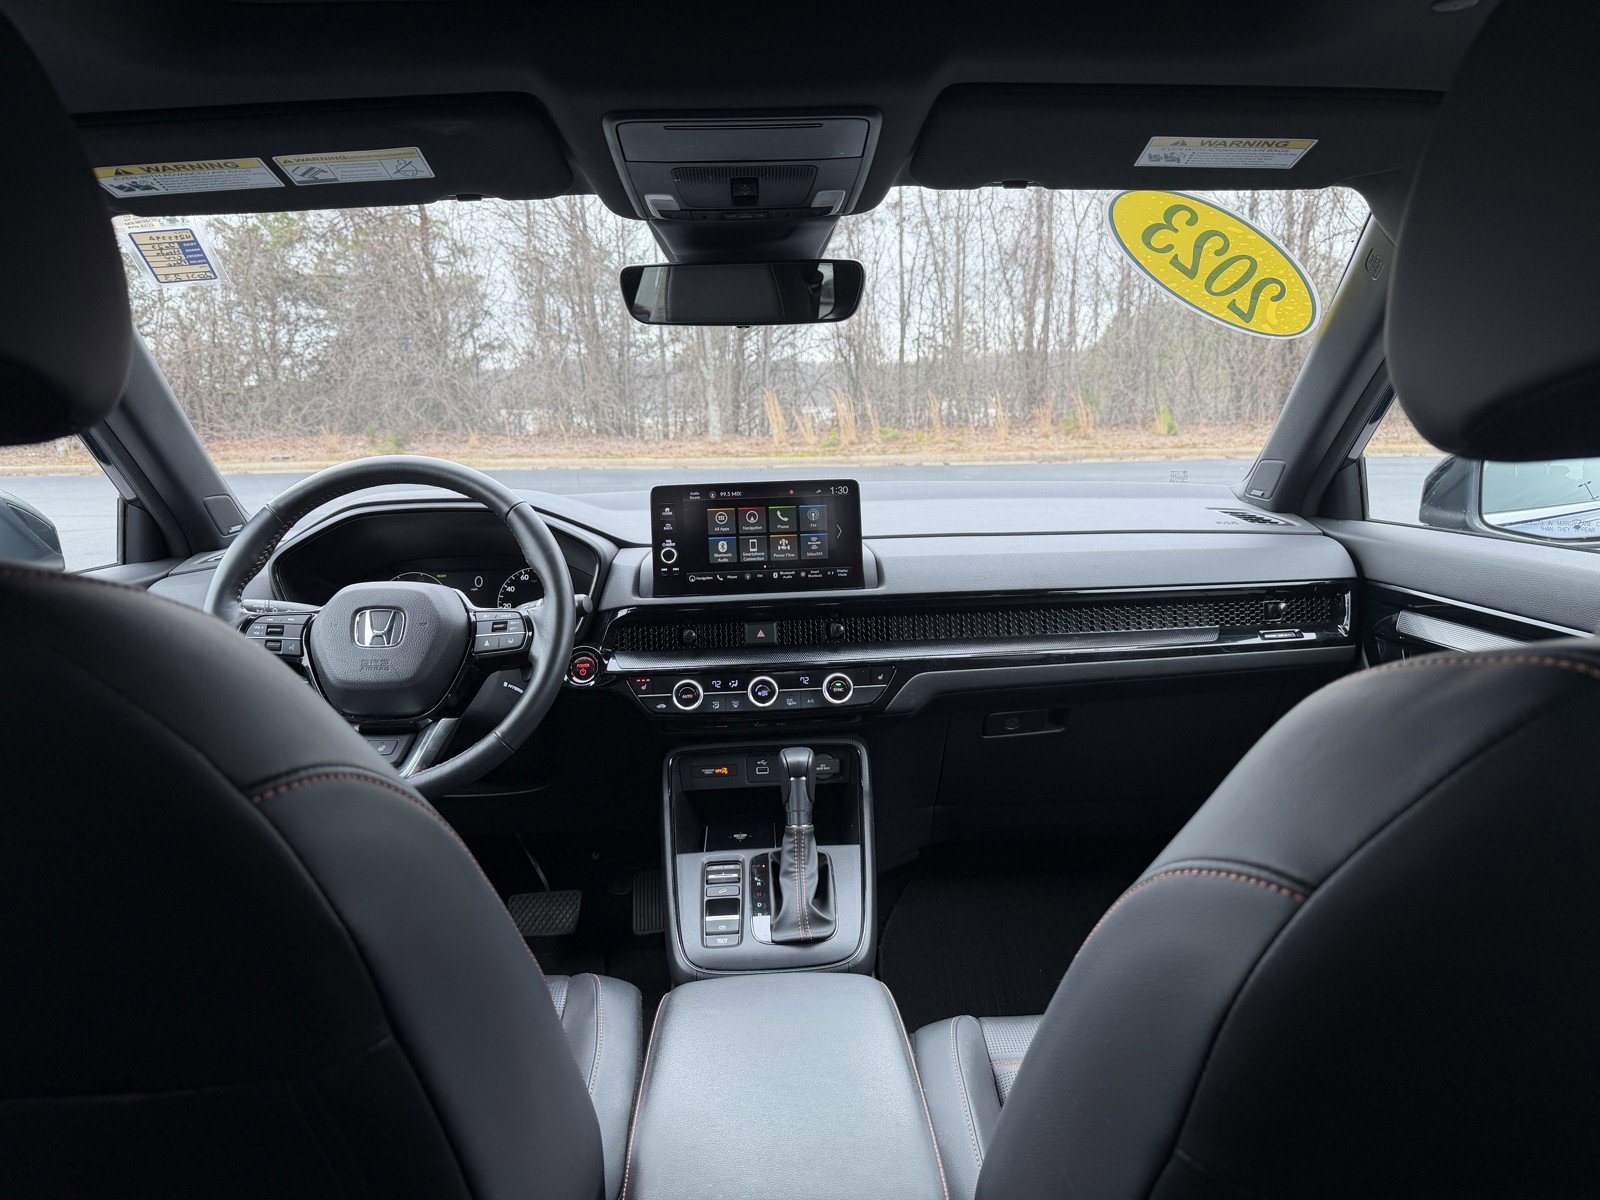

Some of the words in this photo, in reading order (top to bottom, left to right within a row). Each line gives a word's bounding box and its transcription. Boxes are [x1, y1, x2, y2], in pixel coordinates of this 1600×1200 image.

[1199, 139, 1290, 148] WARNING
[293, 155, 348, 163] WARNING
[139, 161, 240, 174] WARNING
[830, 486, 849, 495] 1:30
[474, 575, 484, 588] 0
[519, 573, 530, 581] 60
[506, 585, 516, 593] 40
[711, 680, 721, 688] 72
[800, 676, 809, 685] 72
